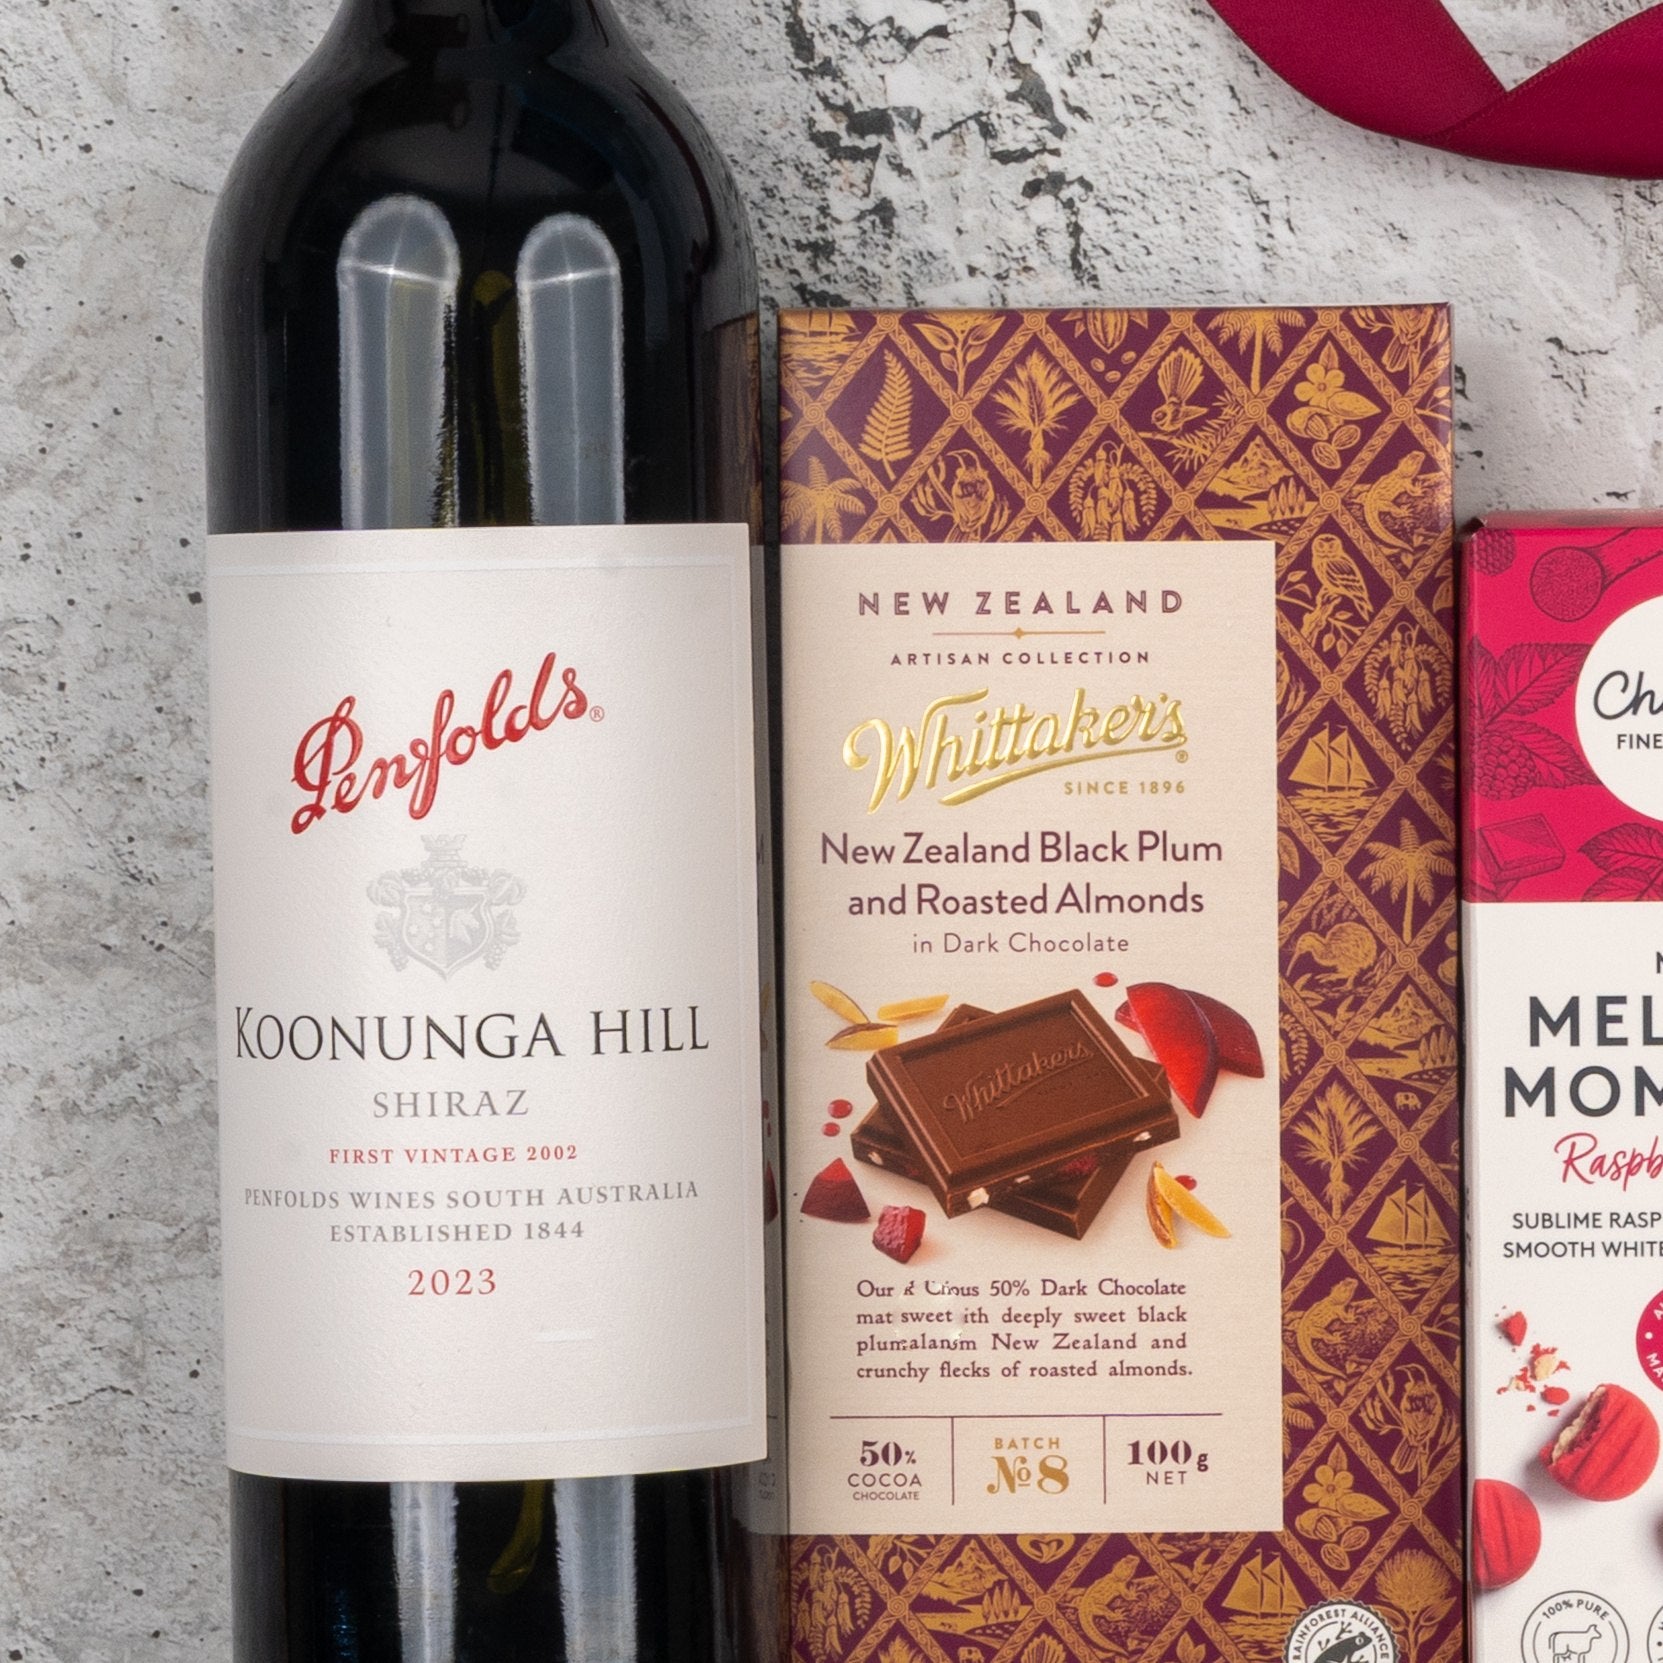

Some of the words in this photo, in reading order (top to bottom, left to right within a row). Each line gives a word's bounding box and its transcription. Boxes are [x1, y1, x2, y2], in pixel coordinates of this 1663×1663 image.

[858, 591, 950, 616] NEW
[975, 589, 1183, 616] ZEALAND
[890, 652, 989, 666] ARTISAN
[1002, 651, 1149, 665] COLLECTION
[290, 651, 589, 836] Penfolds
[841, 686, 1189, 816] Whittaker's
[1063, 780, 1129, 796] SINCE
[1139, 780, 1185, 795] 1896
[821, 831, 896, 865] New
[902, 831, 1030, 864] Zealand
[1040, 830, 1130, 863] Black
[1138, 829, 1223, 862] Plum
[848, 883, 907, 916] and
[916, 882, 1048, 915] Roasted
[1054, 881, 1205, 914] Almonds
[913, 933, 933, 954] in
[943, 932, 999, 954] Dark
[1008, 931, 1129, 953] Chocolate
[234, 1006, 565, 1061] KOONUNGA
[591, 1005, 709, 1055] HILL
[373, 1089, 529, 1119] SHIRAZ
[329, 1148, 394, 1164] FIRST
[404, 1146, 516, 1164] VINTAGE
[526, 1144, 577, 1161] 2002
[244, 1187, 340, 1209] PENFOLDS
[348, 1191, 435, 1210] WINES
[446, 1188, 545, 1209] SOUTH
[557, 1180, 699, 1205] AUSTRALIA
[329, 1223, 512, 1243] ESTABLISHED
[525, 1220, 585, 1240] 1844
[1512, 1211, 1603, 1230] SUBLIME
[1609, 1211, 1662, 1229] RASP
[1503, 1241, 1595, 1259] SMOOTH
[408, 1268, 496, 1296] 2023
[856, 1279, 895, 1298] Our
[989, 1279, 1030, 1297] 50%
[1040, 1278, 1088, 1297] Dark
[1097, 1277, 1187, 1296] Chocolate
[900, 1310, 953, 1324] sweet
[1001, 1305, 1063, 1330] deeply
[1073, 1310, 1126, 1324] sweet
[1137, 1305, 1188, 1323] black
[991, 1331, 1040, 1351] New
[1052, 1332, 1138, 1350] Zealand
[1150, 1331, 1187, 1350] and
[856, 1360, 930, 1383] crunchy
[939, 1360, 991, 1378] flecks
[1000, 1359, 1022, 1378] of
[1029, 1359, 1098, 1378] roasted
[1108, 1358, 1193, 1377] almonds.
[859, 1439, 917, 1467] 50%
[994, 1436, 1060, 1451] BATCH
[847, 1472, 922, 1488] COCOA
[1146, 1470, 1188, 1486] NET
[851, 1490, 920, 1502] CHOCOLATE
[1541, 1598, 1574, 1620] 100%
[1575, 1598, 1610, 1621] PURE
[1291, 1607, 1347, 1661] RAINFOREST
[1349, 1609, 1390, 1660] ALLIANCE
